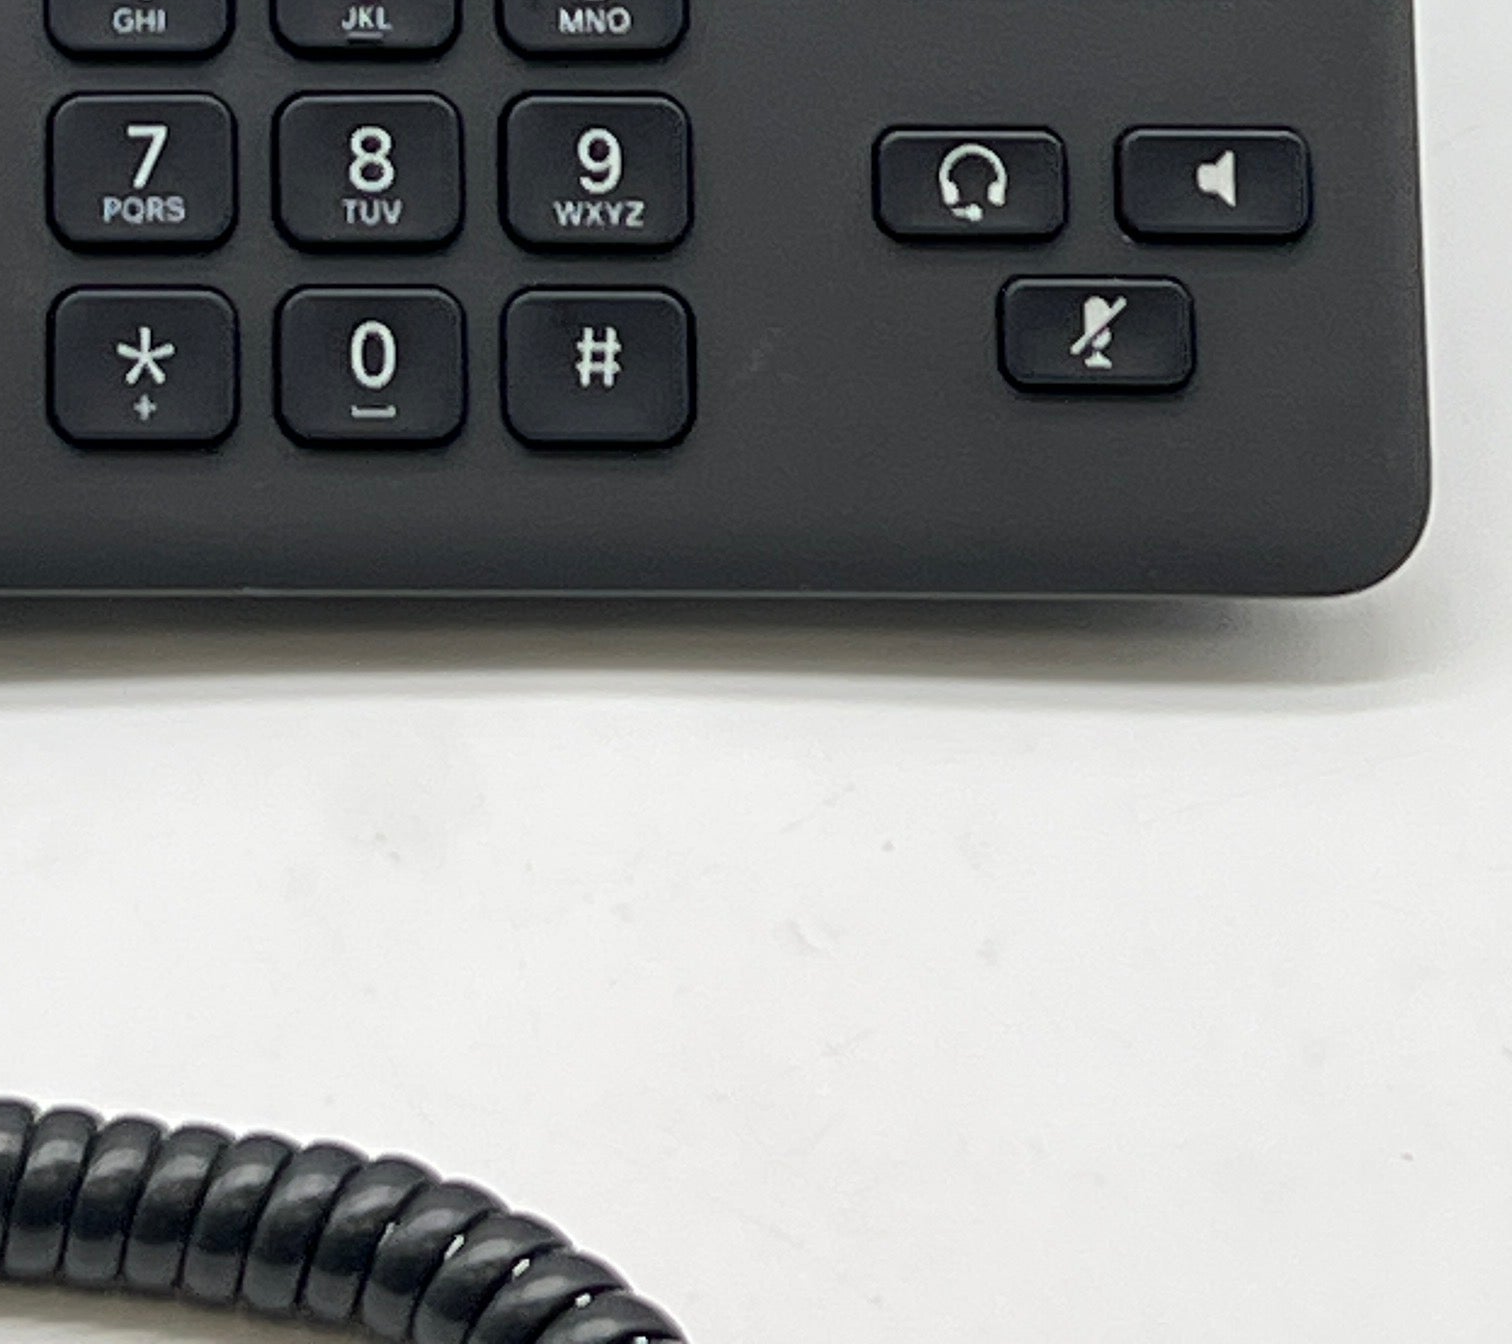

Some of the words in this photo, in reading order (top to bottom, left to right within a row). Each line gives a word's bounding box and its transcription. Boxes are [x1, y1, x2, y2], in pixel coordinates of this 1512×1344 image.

[112, 7, 166, 34] GHI
[341, 6, 392, 32] JKL
[558, 7, 631, 34] MNO
[127, 125, 167, 189] 7
[349, 126, 395, 192] 8
[577, 128, 622, 194] 9
[103, 195, 186, 225] PQRS
[342, 198, 402, 226] TUV
[553, 200, 645, 227] WXYZ
[351, 321, 396, 389] 0
[575, 326, 622, 387] #
